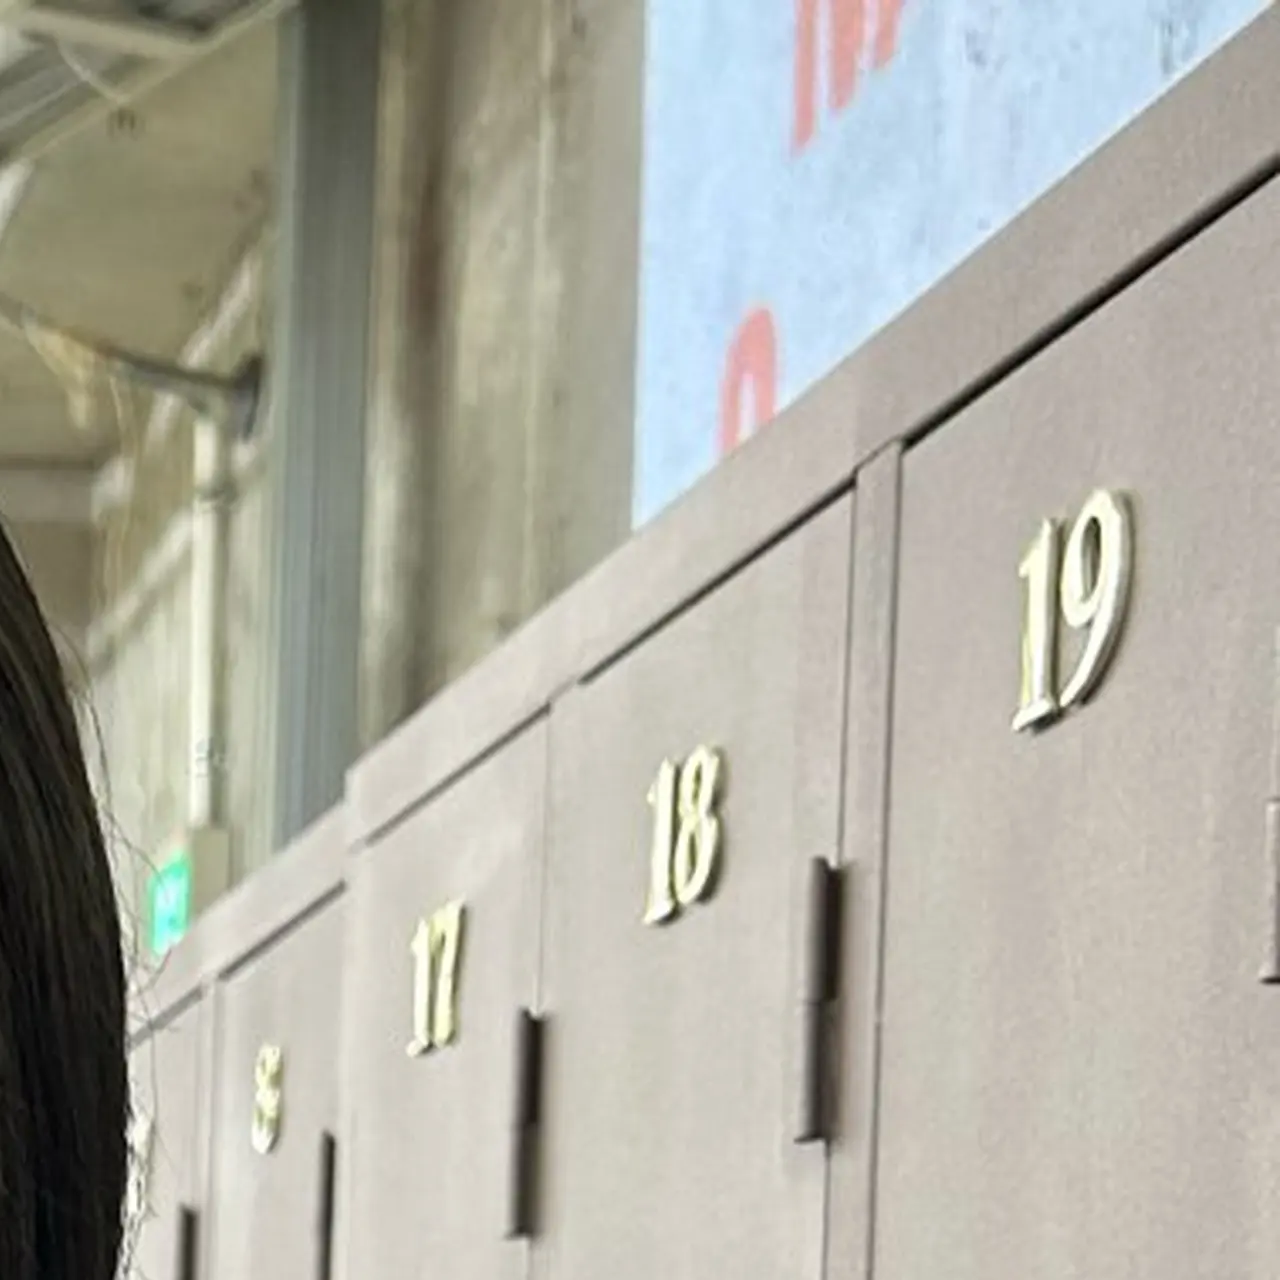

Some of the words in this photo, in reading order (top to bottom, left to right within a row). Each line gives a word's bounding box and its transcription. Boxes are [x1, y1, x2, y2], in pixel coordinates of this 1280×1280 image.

[1011, 489, 1132, 733] 19
[643, 744, 723, 926] 18
[405, 893, 464, 1058] 17
